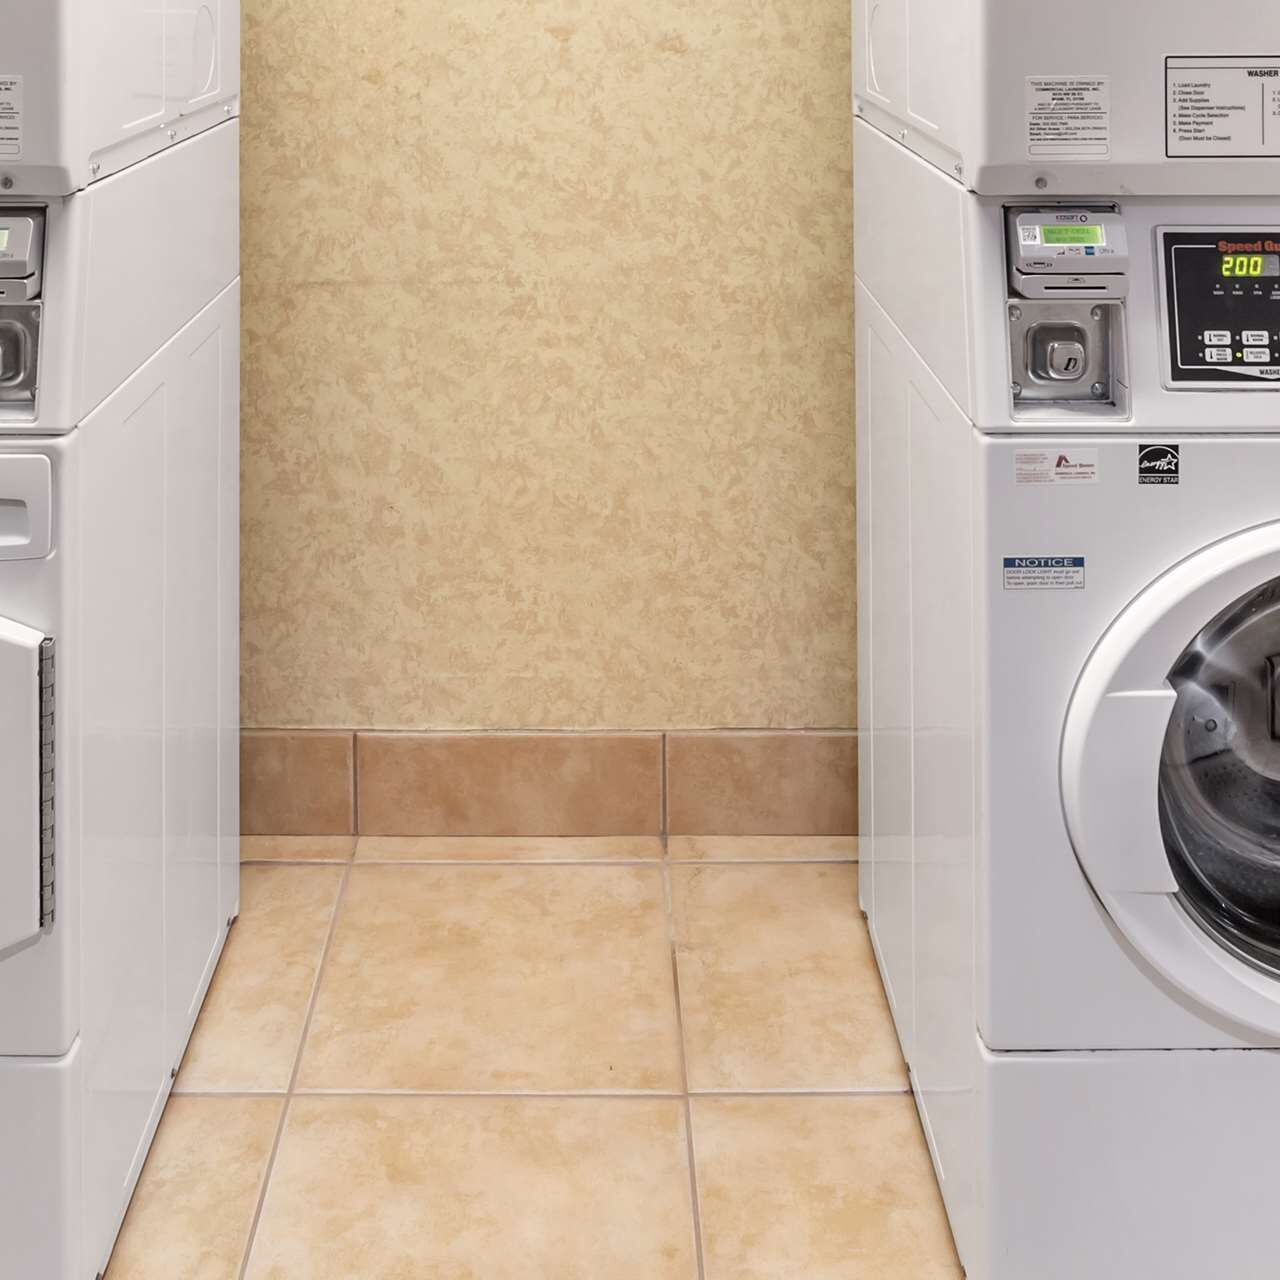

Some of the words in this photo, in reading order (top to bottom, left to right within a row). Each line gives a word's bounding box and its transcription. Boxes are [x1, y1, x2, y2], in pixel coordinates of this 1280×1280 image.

[1218, 241, 1262, 254] Speed
[1222, 257, 1262, 277] 200
[1015, 559, 1073, 567] NOTICE
